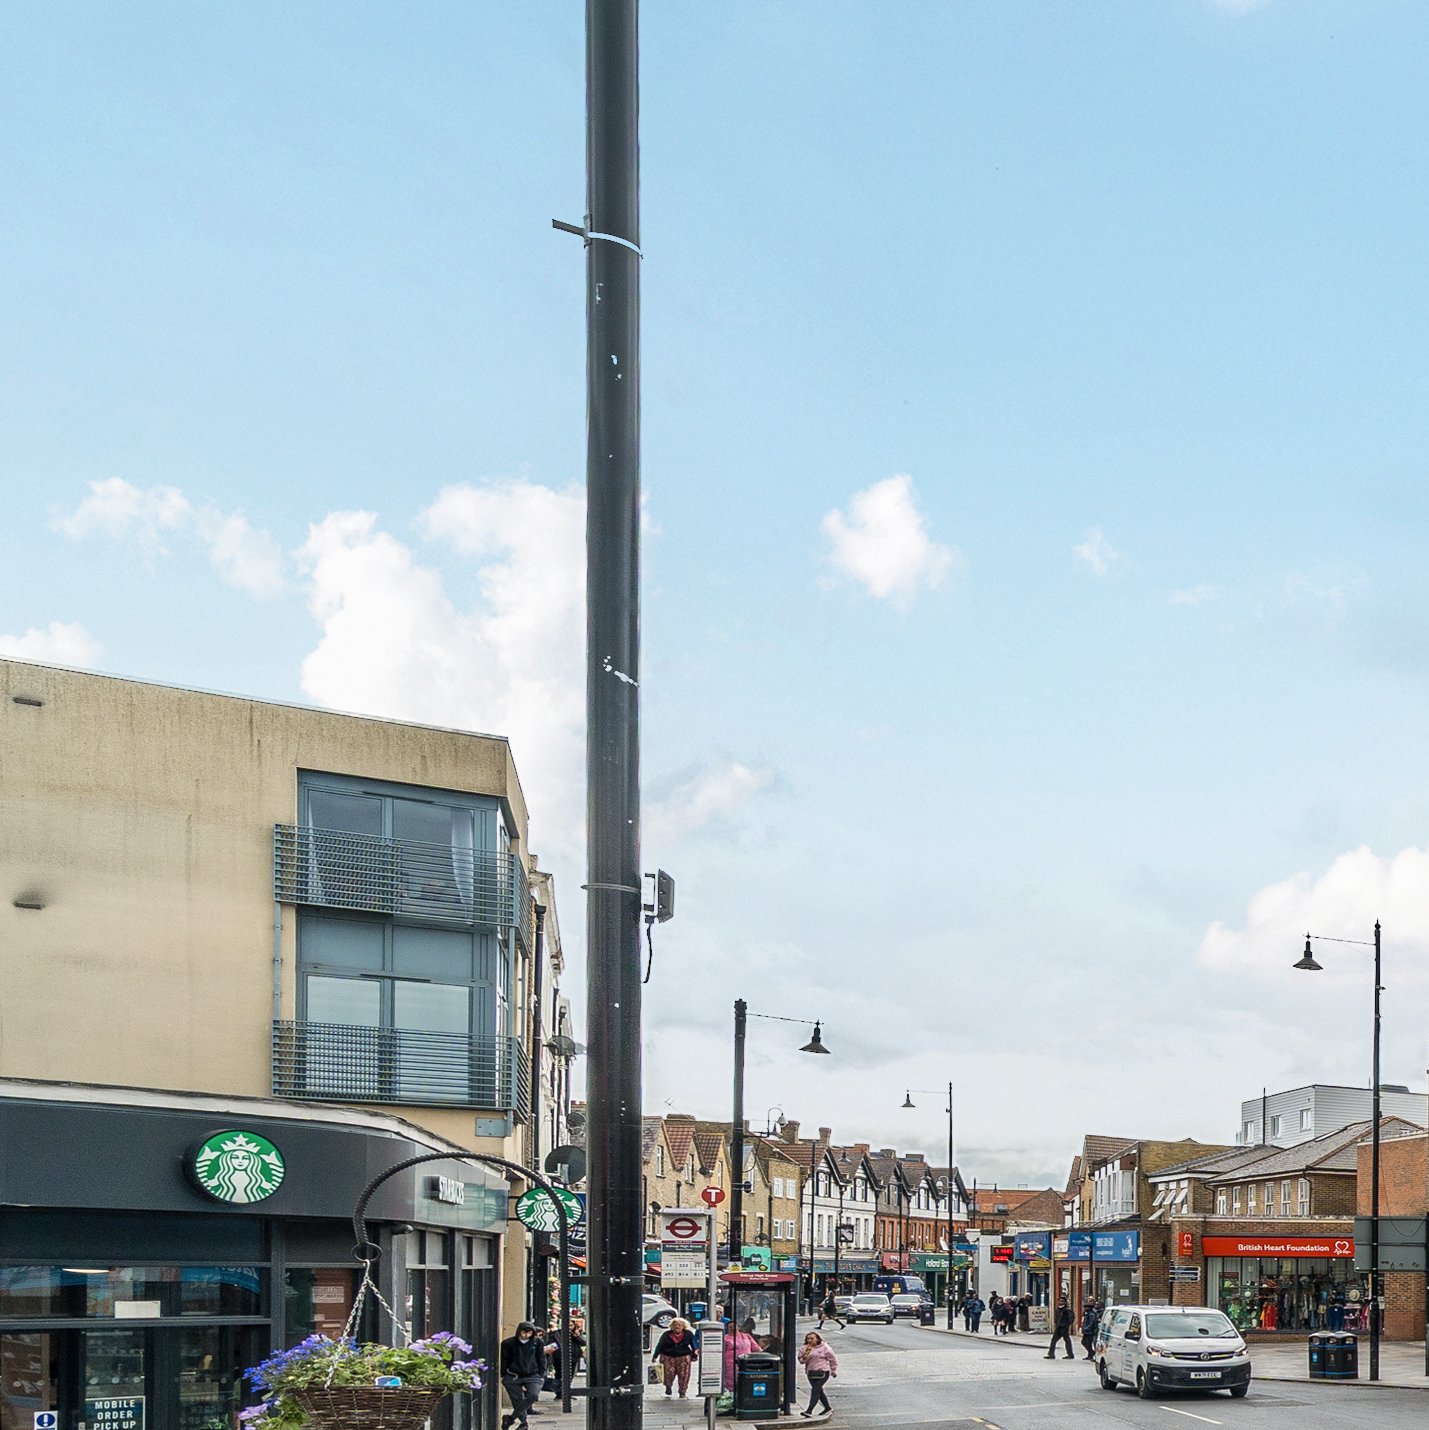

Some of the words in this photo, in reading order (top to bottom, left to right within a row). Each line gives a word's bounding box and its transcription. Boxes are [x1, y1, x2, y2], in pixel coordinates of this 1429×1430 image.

[707, 1189, 720, 1202] T
[1286, 1244, 1330, 1252] Foundation
[95, 1399, 136, 1410] MOBILE
[97, 1410, 133, 1420] ORDER
[93, 1420, 119, 1430] PICK
[122, 1420, 136, 1429] UP
